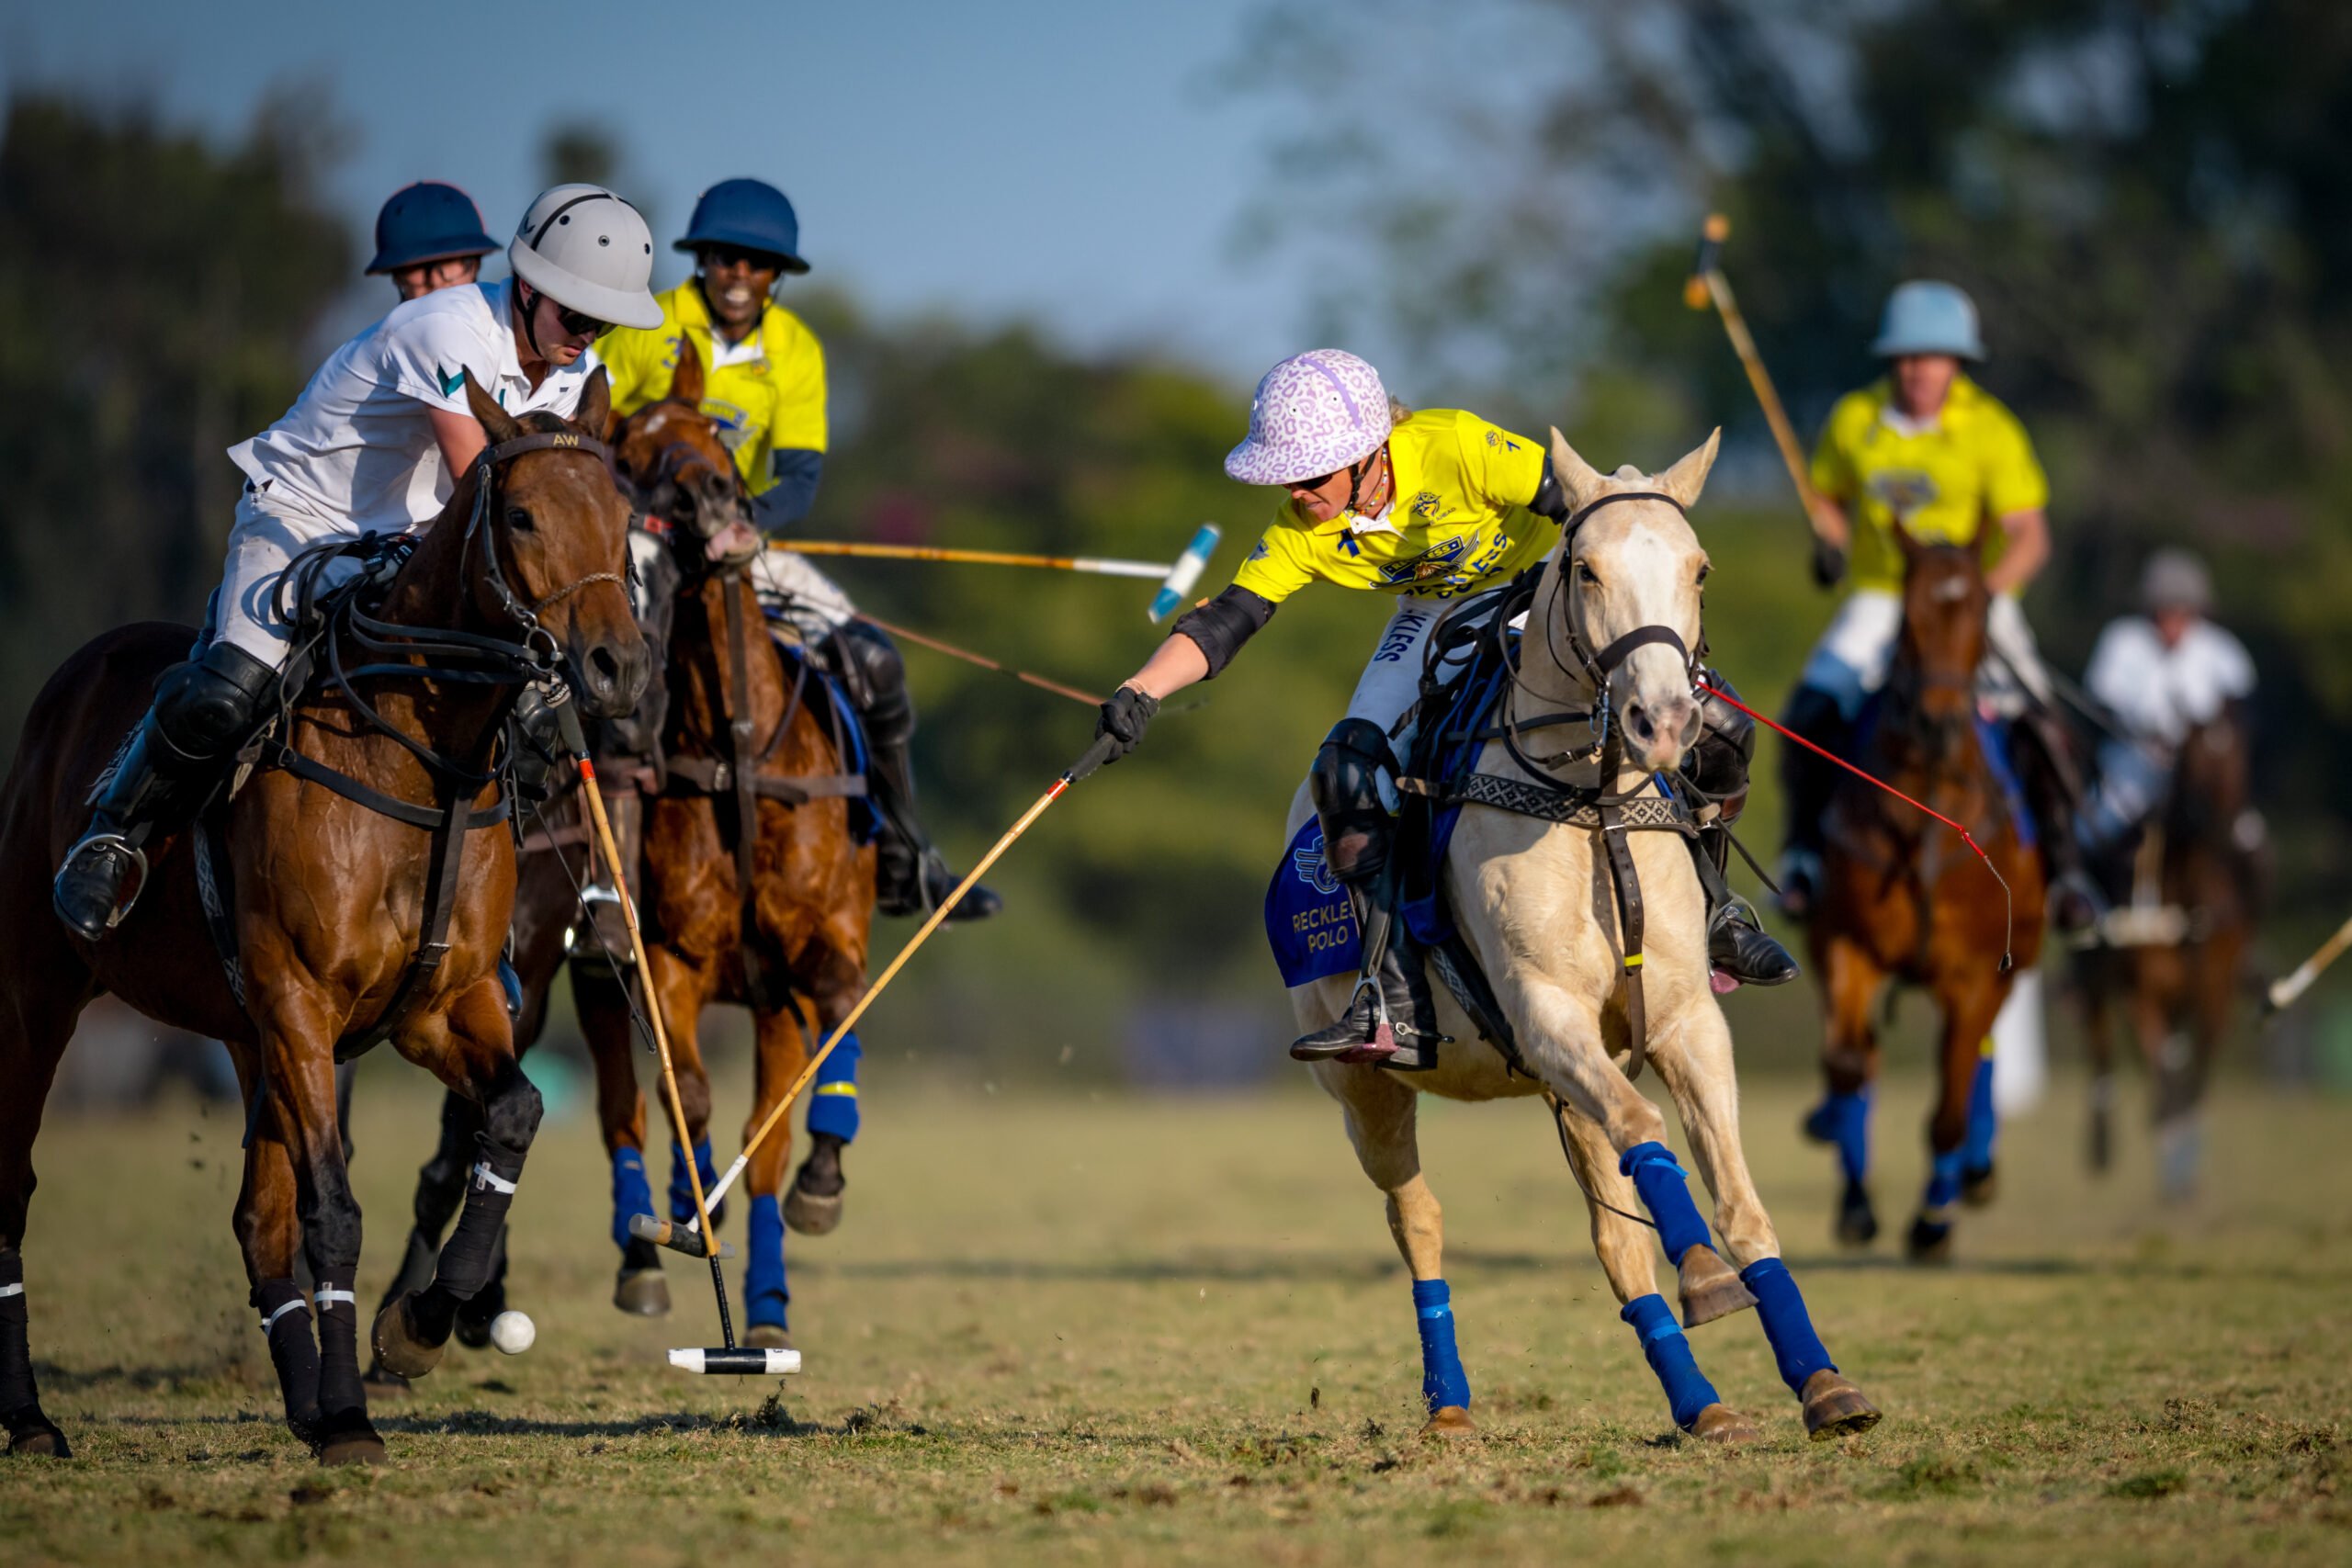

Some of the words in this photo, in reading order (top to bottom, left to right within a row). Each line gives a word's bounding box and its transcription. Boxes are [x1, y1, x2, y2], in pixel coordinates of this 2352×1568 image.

[662, 336, 683, 369] 3
[553, 434, 579, 447] AW
[1373, 610, 1429, 662] KLESS
[1307, 926, 1349, 953] POLO
